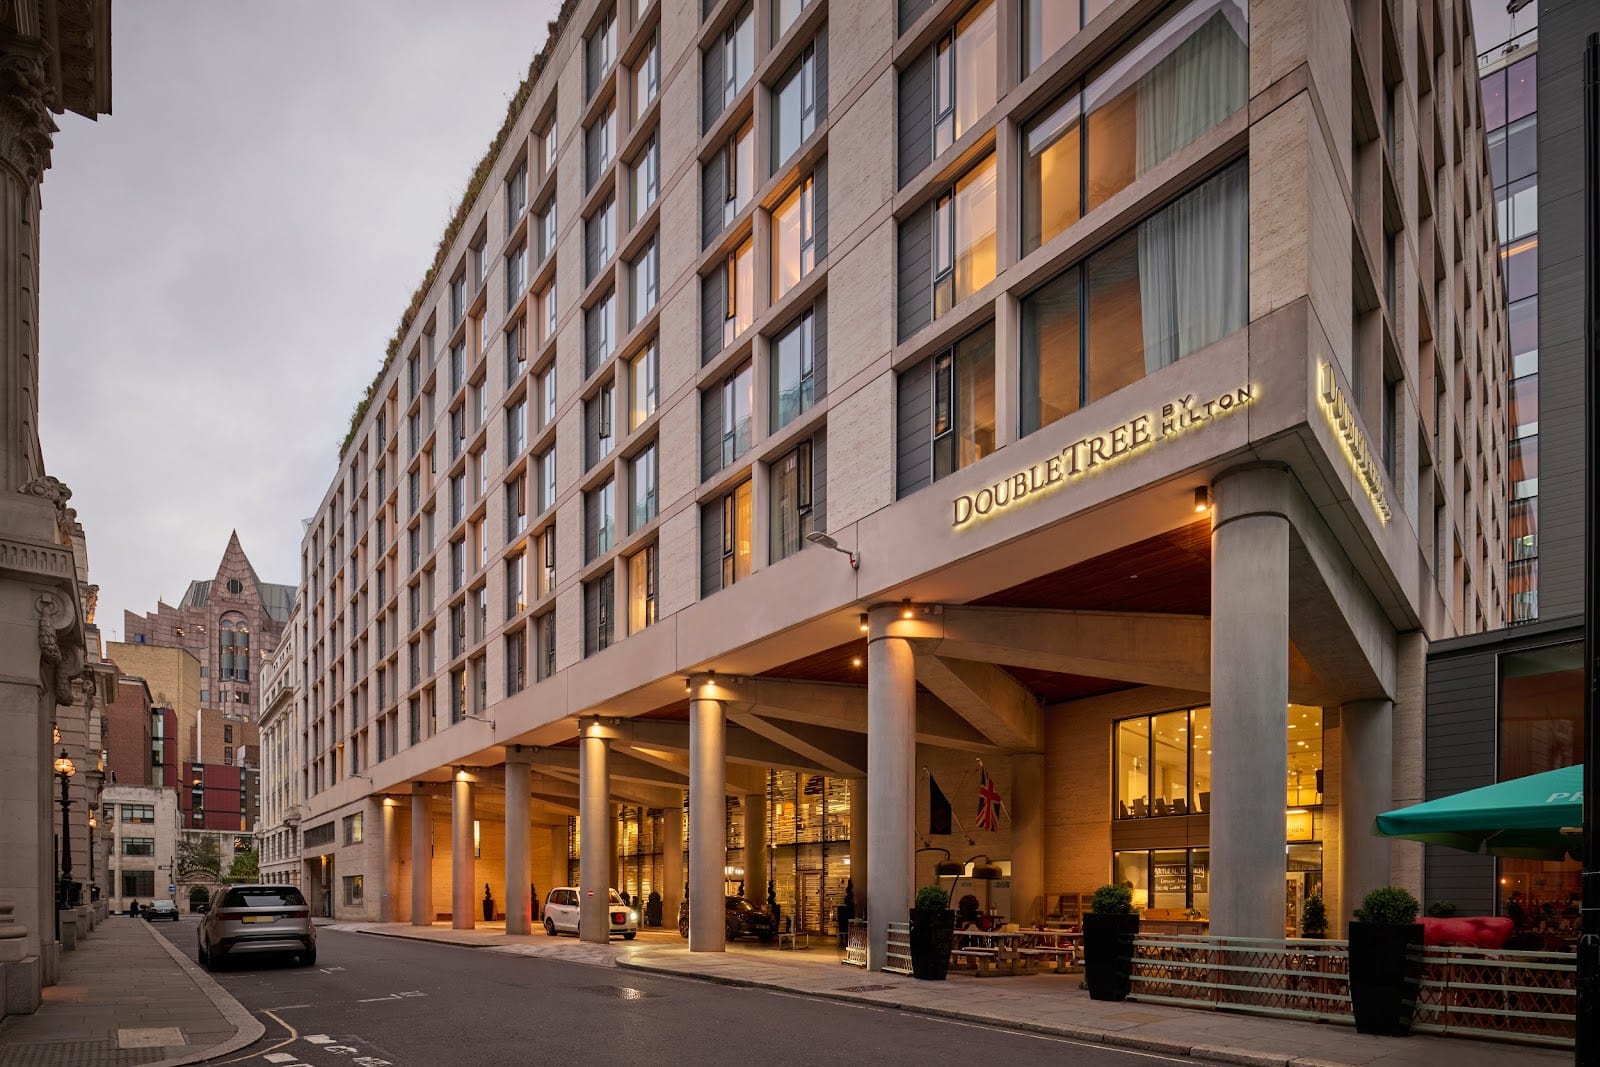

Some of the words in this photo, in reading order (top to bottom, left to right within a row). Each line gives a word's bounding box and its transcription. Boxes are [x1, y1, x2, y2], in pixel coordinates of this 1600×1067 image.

[1163, 394, 1193, 417] BY
[1163, 384, 1254, 435] HILTON
[1545, 792, 1584, 802] PR
